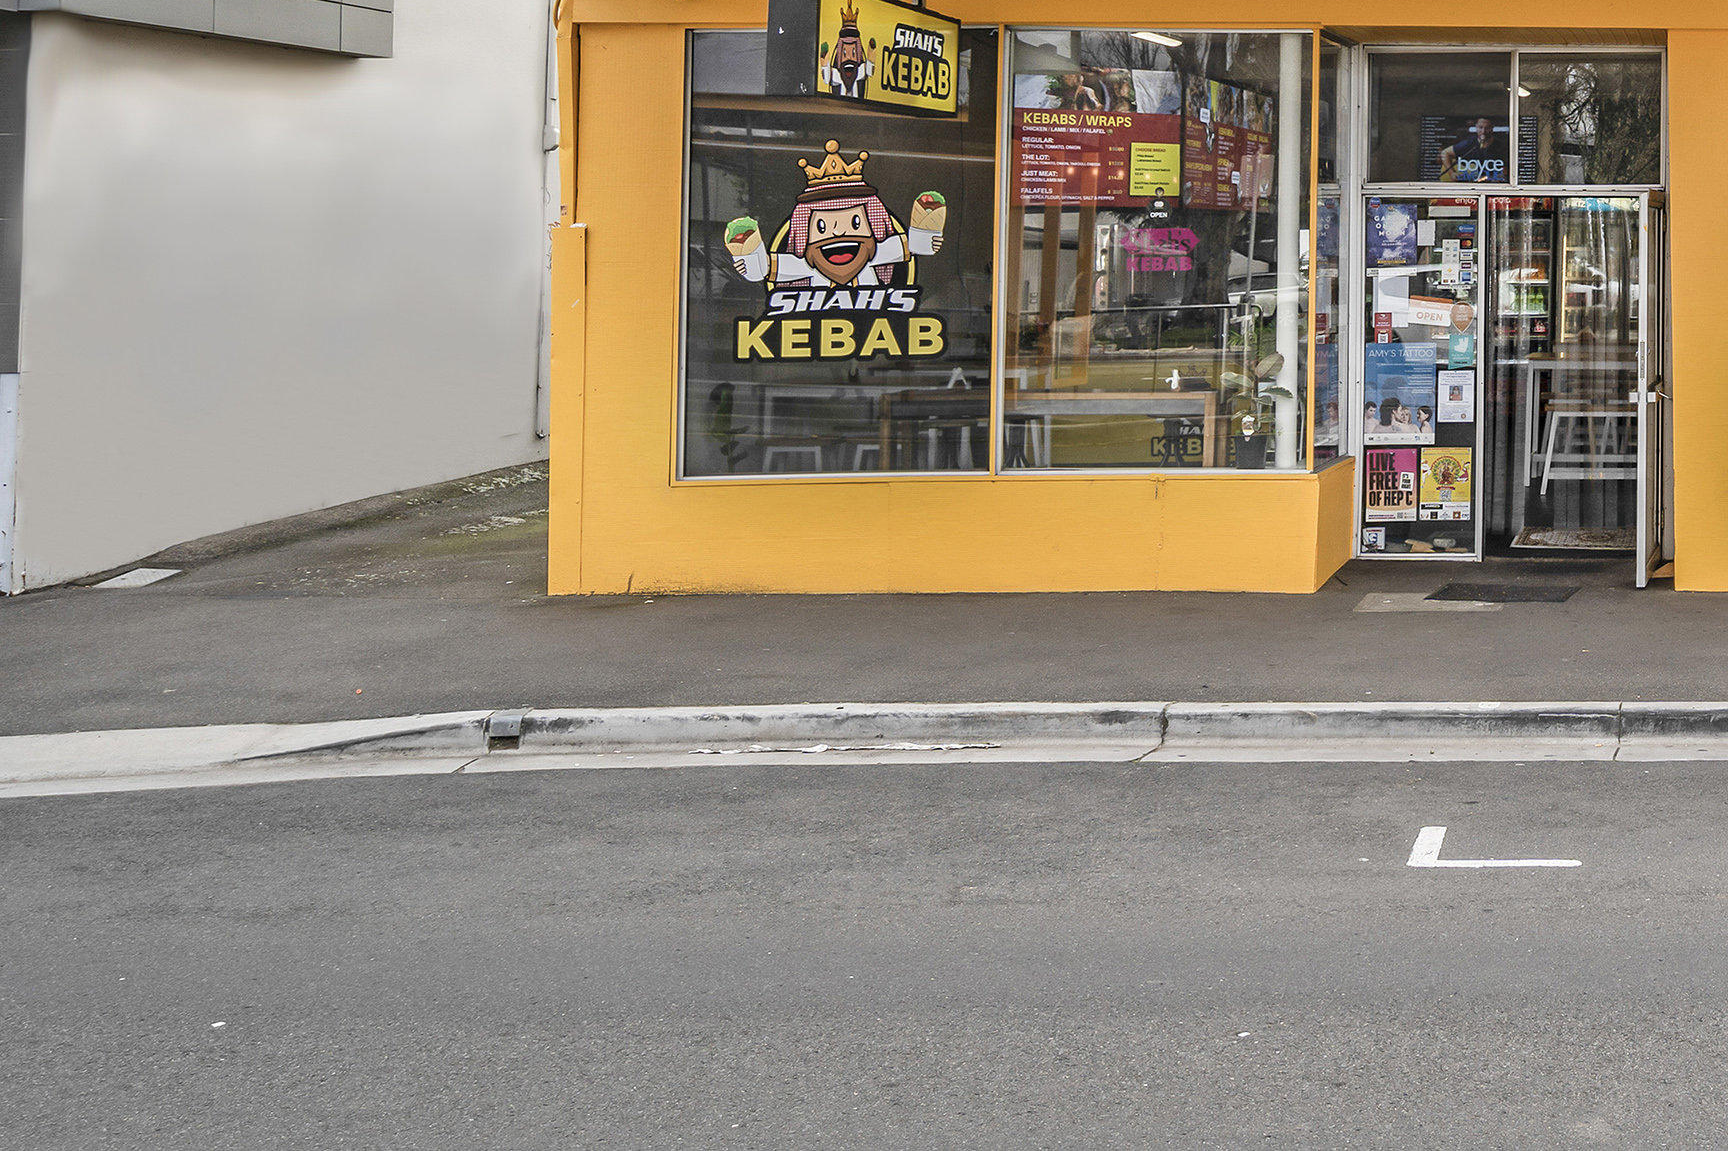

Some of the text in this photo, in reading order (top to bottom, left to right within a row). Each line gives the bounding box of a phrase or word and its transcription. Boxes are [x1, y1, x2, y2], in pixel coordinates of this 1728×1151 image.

[894, 28, 943, 57] SHAH'S
[883, 50, 949, 96] KEBAB
[1023, 112, 1077, 126] KEBABS
[1085, 115, 1132, 128] WRAPS
[1457, 156, 1504, 181] boyce
[1454, 197, 1477, 205] enjoy
[1126, 256, 1192, 272] KEBAB
[767, 287, 919, 316] SHAH'S
[1416, 311, 1444, 322] OPEN
[737, 317, 944, 359] KEBAB
[1368, 349, 1434, 358] AMY'S TATTOO
[1369, 452, 1396, 471] LIVE
[1369, 472, 1399, 491] FREE
[1368, 491, 1382, 507] OF
[1383, 490, 1404, 507] HEP
[1405, 491, 1413, 506] C
